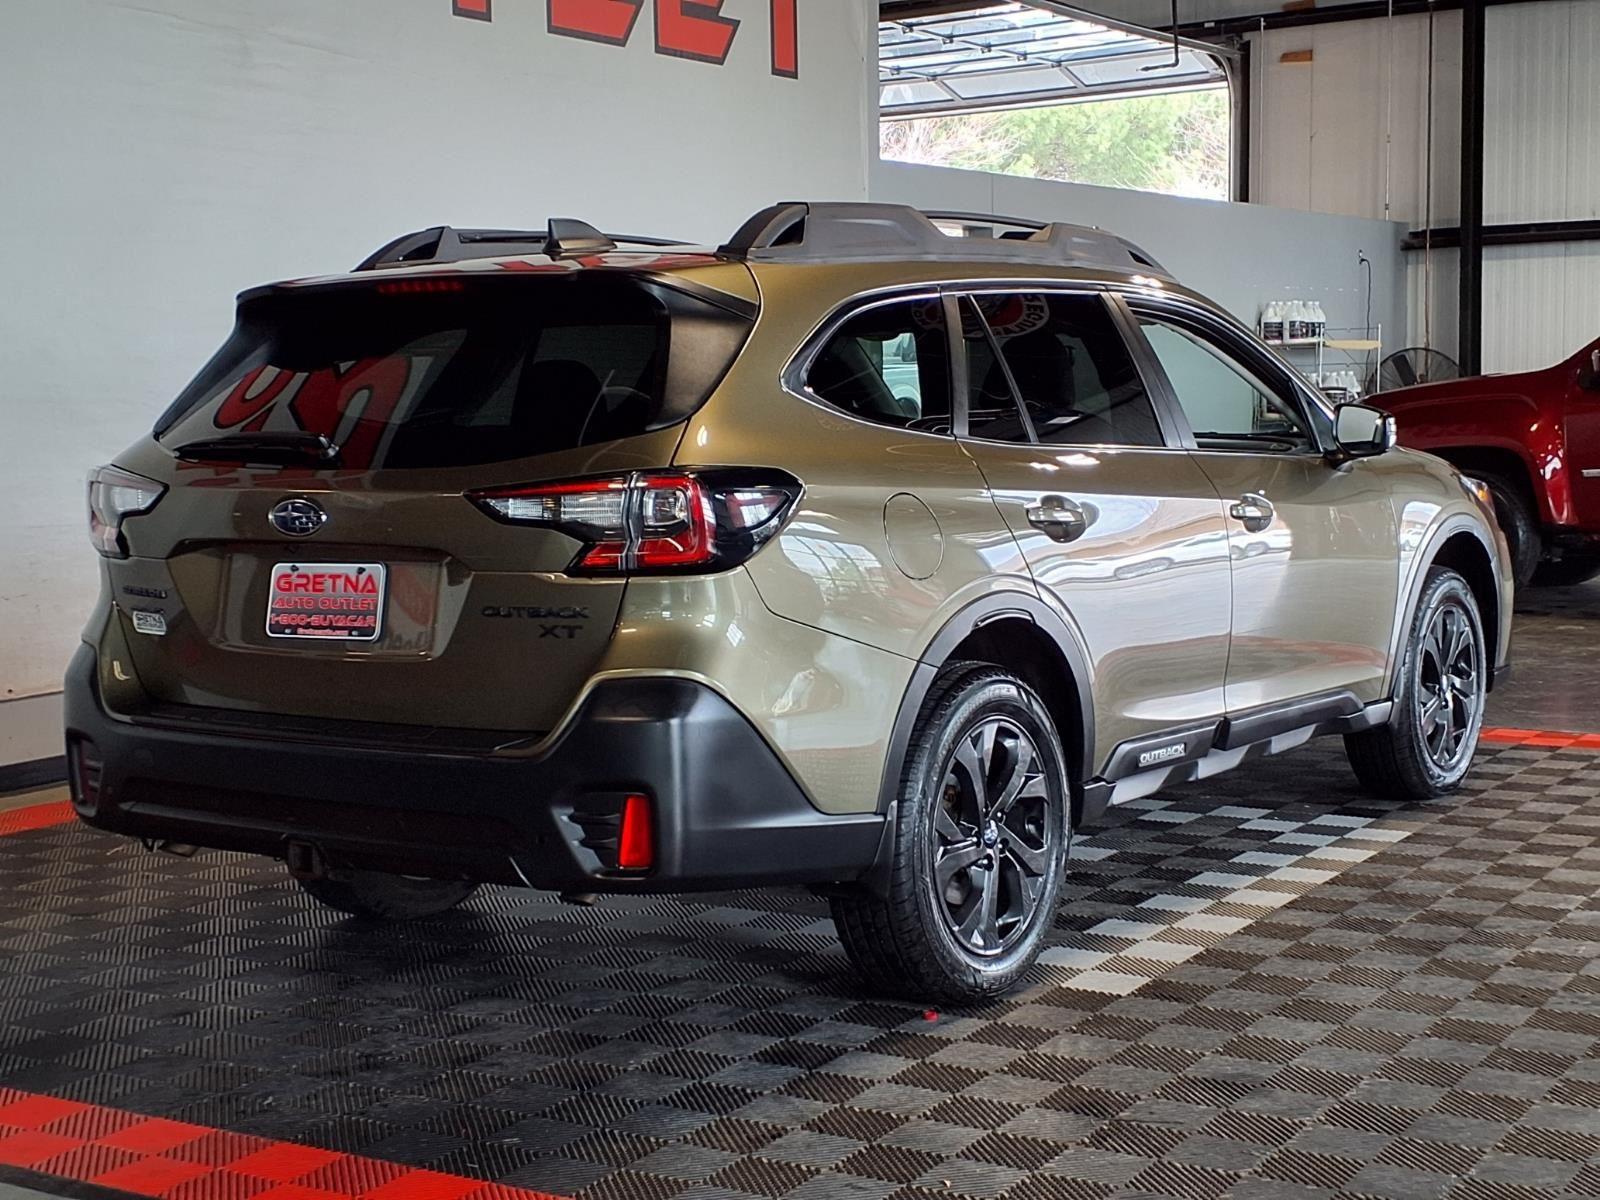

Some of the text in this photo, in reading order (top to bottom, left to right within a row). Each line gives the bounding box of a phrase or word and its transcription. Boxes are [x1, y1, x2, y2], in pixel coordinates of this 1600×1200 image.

[276, 573, 377, 594] GRETNA
[272, 597, 377, 610] AUTO OUTLET
[482, 606, 589, 619] OUTBACK
[539, 624, 584, 639] XT
[1139, 743, 1185, 765] OUTBACK
